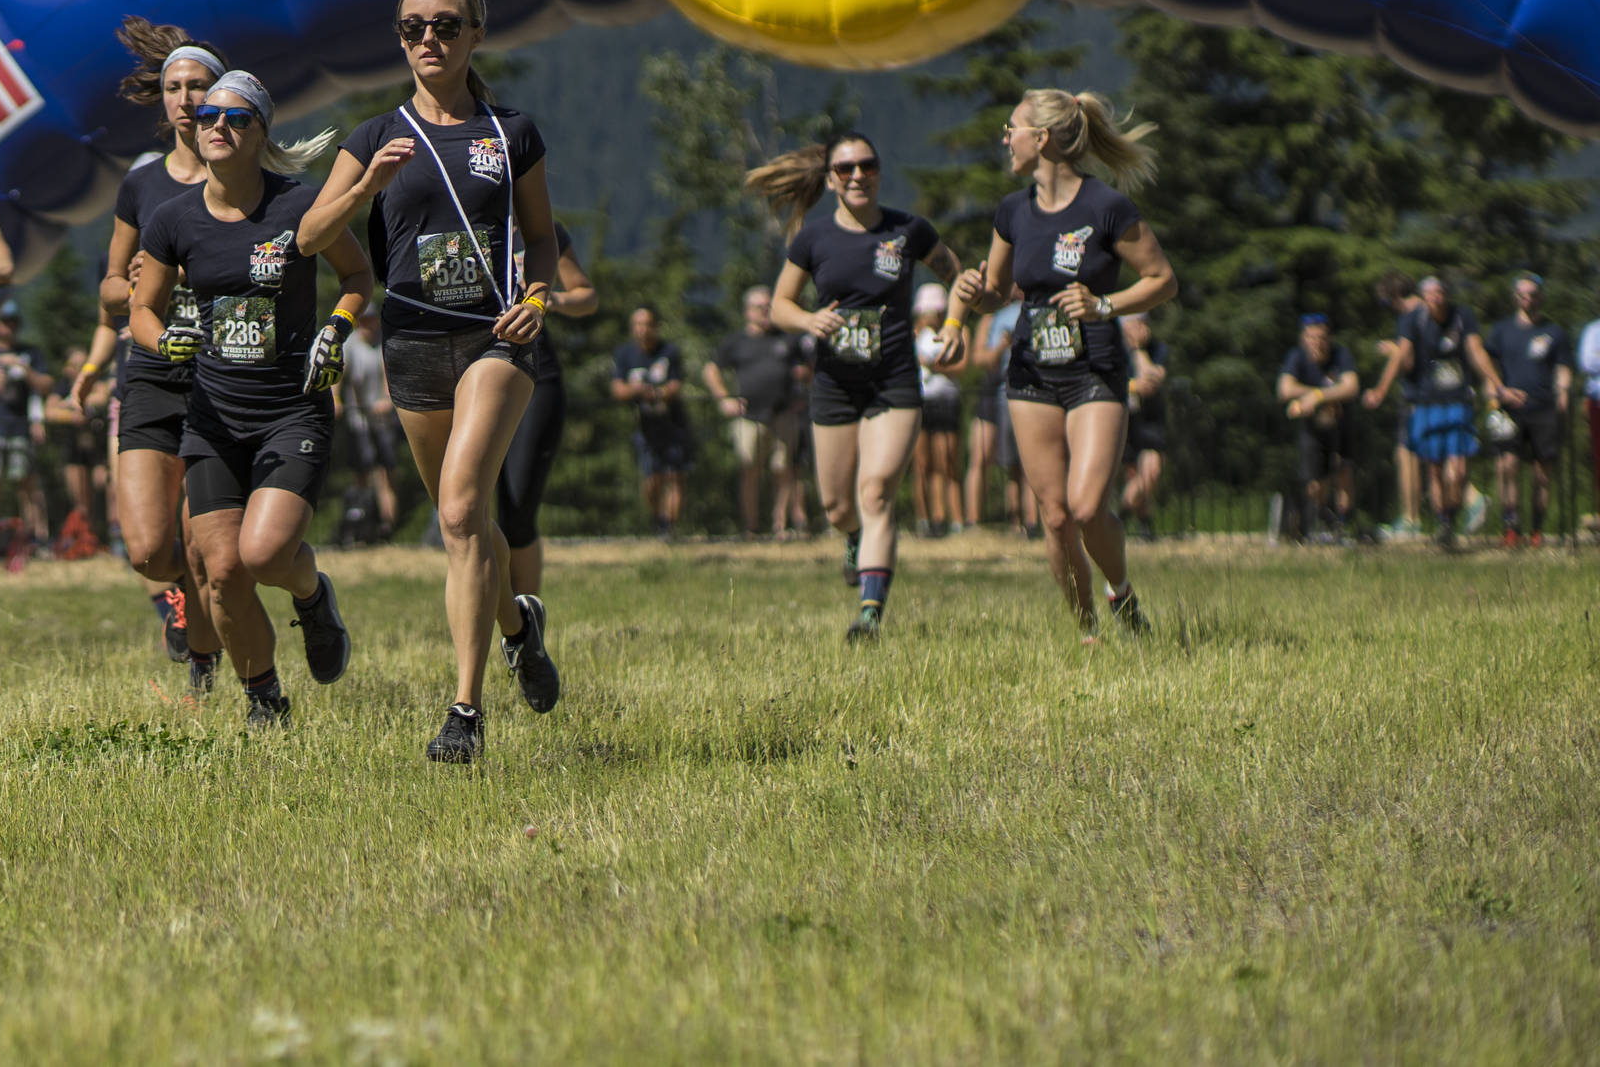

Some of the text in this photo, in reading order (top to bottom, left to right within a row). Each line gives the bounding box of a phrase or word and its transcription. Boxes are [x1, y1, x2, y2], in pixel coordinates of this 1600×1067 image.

[470, 154, 503, 169] 400
[250, 254, 268, 265] Red
[251, 263, 282, 275] 400
[435, 257, 478, 287] 528
[433, 285, 483, 296] WHISTLER
[434, 294, 464, 302] OLYMPIC
[175, 295, 198, 319] 30
[225, 318, 261, 345] 236
[840, 325, 870, 349] 219
[1040, 325, 1071, 349] 160
[221, 345, 265, 354] WHISTLER
